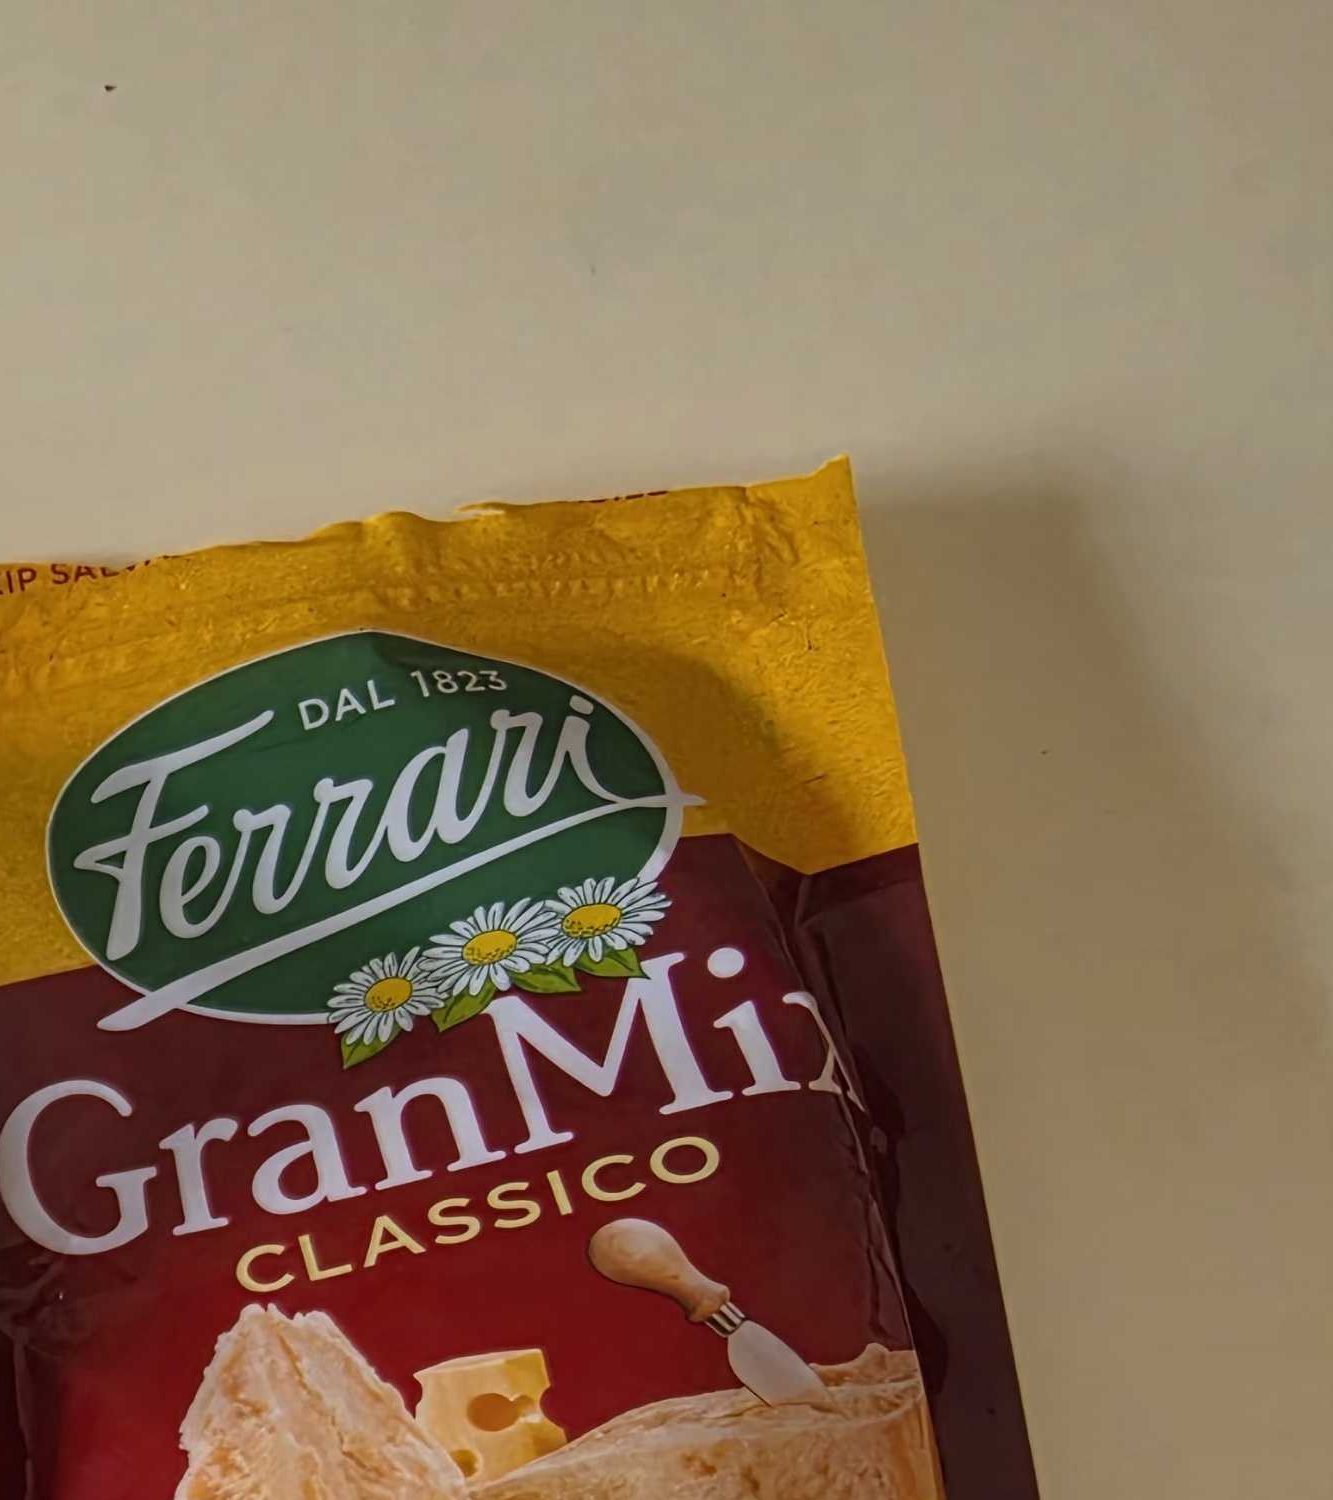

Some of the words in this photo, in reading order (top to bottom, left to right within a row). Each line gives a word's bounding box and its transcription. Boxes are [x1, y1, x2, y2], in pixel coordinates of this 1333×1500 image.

[297, 679, 396, 731] DAL
[409, 669, 508, 698] 1823
[74, 696, 705, 962] Ferrari
[235, 1135, 721, 1293] CLASSICO
